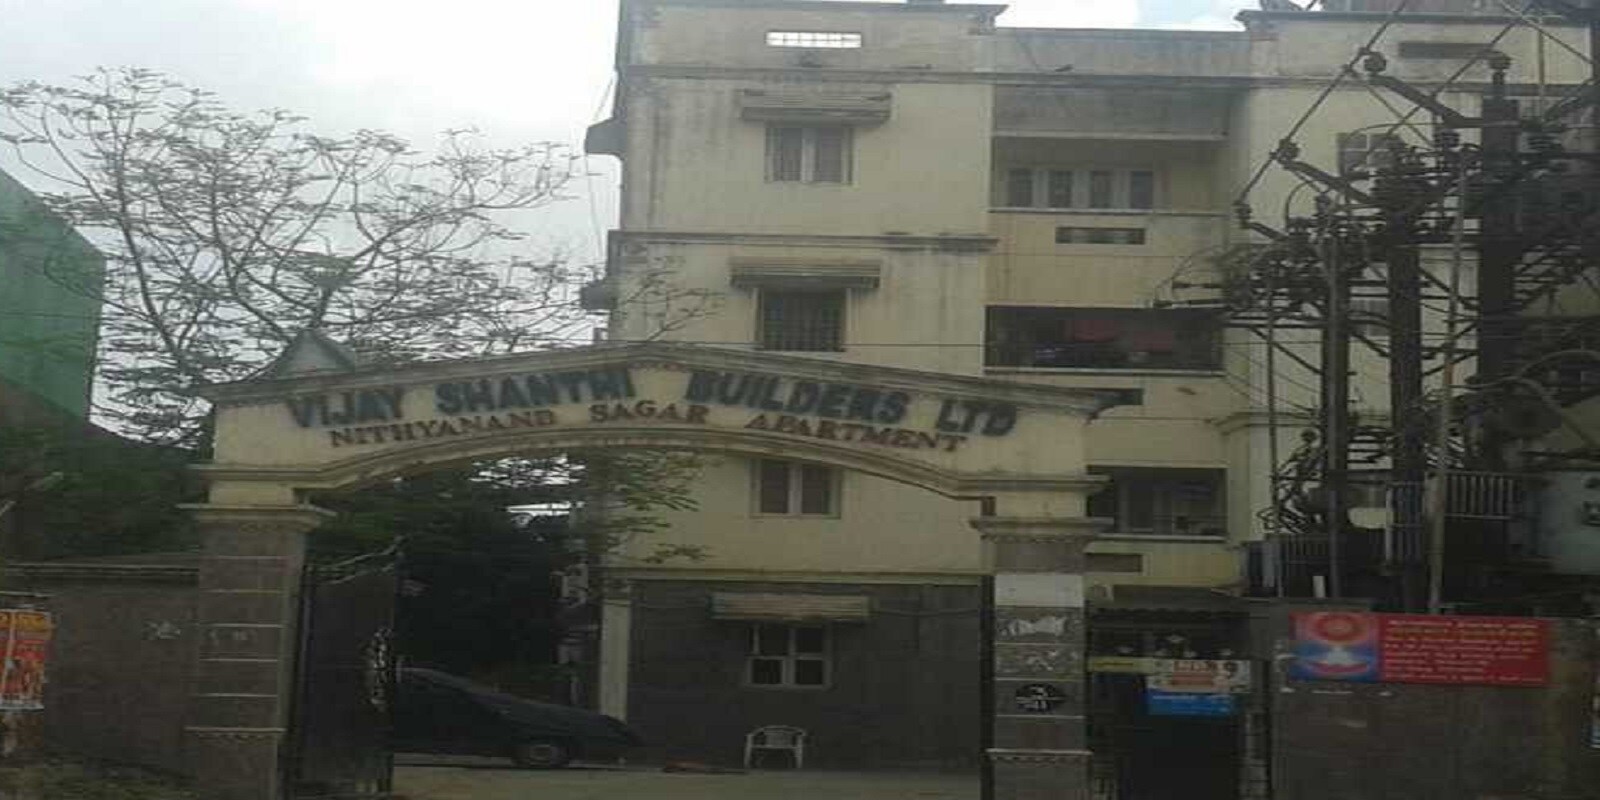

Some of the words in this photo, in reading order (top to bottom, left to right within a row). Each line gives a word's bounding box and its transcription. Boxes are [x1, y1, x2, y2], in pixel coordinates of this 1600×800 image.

[285, 386, 404, 428] VIJAY
[433, 368, 635, 414] SHANTHI
[685, 369, 910, 425] BUILDERS
[934, 397, 1017, 437] LTD
[590, 400, 709, 424] SAGAR
[744, 412, 967, 452] APARTMENT
